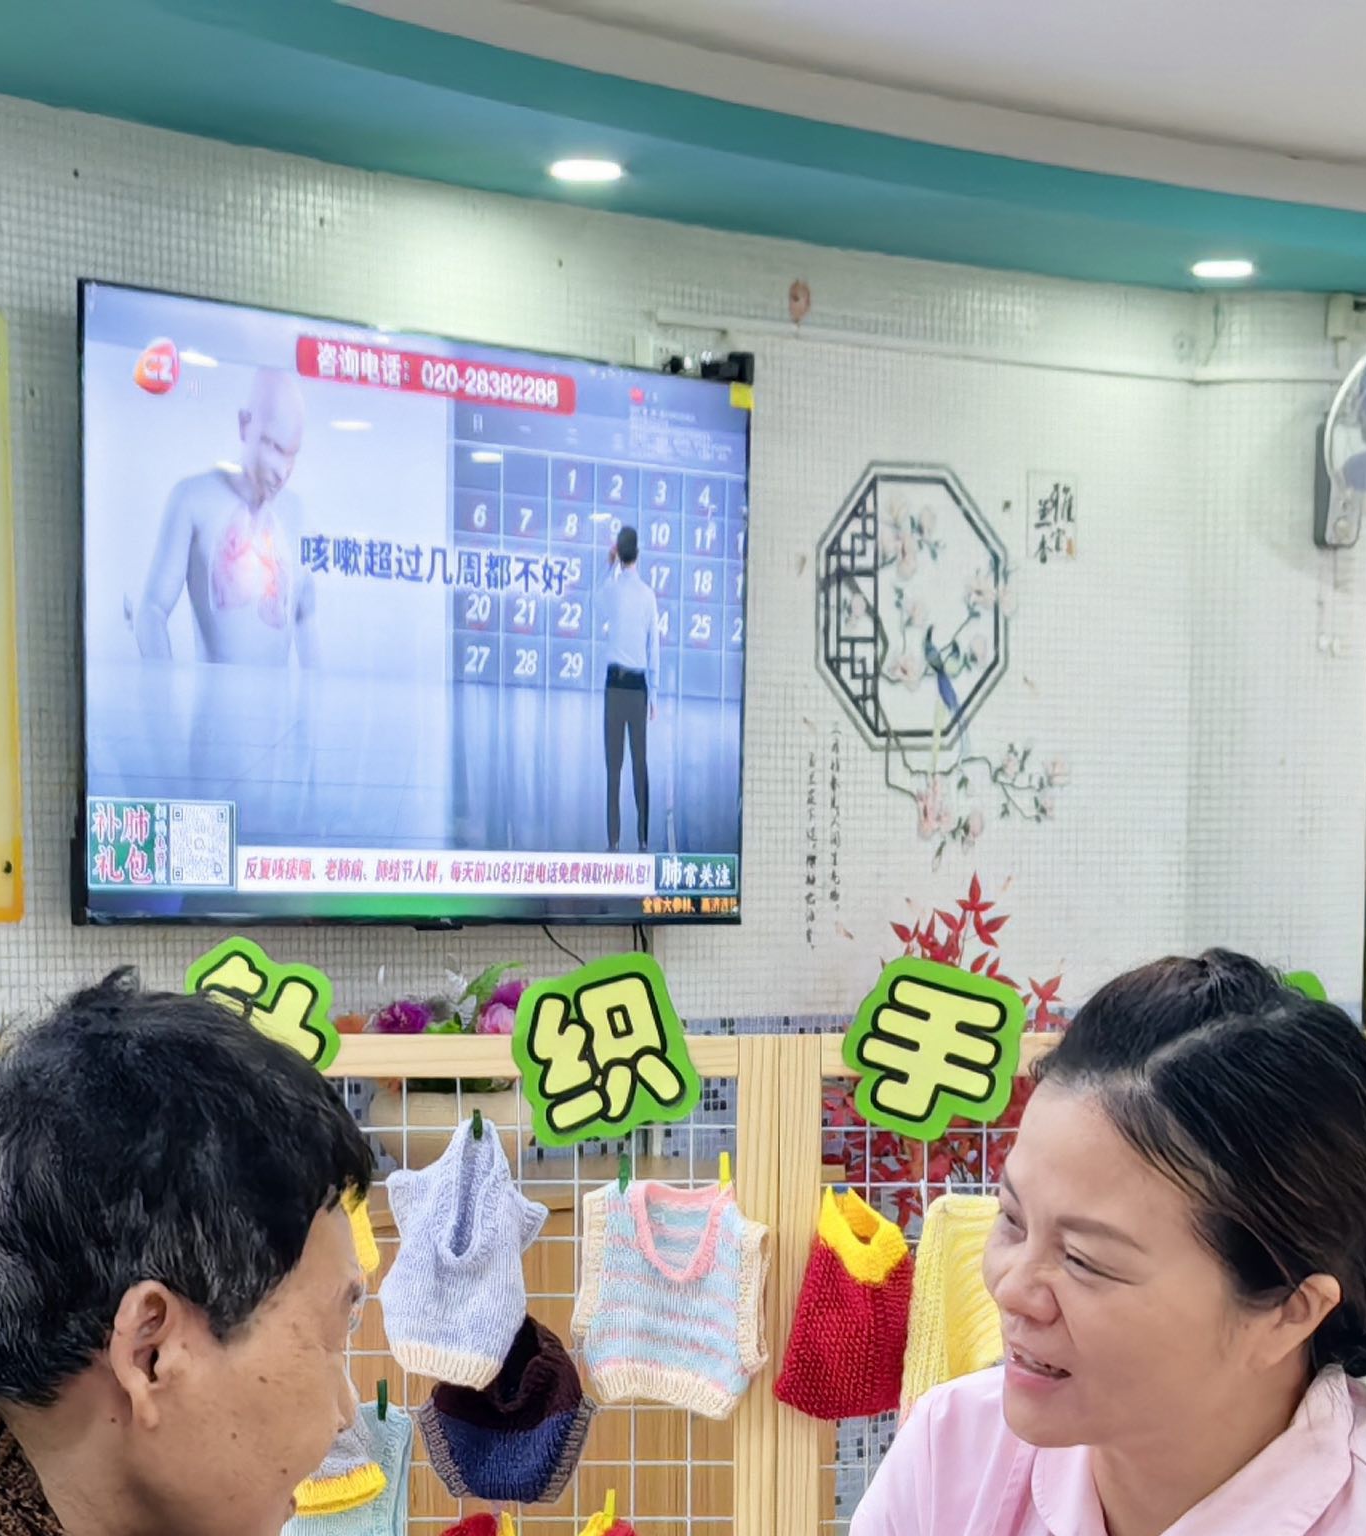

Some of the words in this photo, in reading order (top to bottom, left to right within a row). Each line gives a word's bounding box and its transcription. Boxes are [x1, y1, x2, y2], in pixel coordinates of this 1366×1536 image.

[420, 360, 559, 409] 020-28382288
[567, 469, 577, 493] 1
[611, 474, 623, 499] 2
[654, 480, 667, 505] 3
[698, 485, 711, 509] 4
[473, 504, 487, 528] 6
[519, 508, 533, 532] 7
[565, 513, 579, 537] 8
[650, 522, 671, 545] 10
[299, 534, 569, 597] 咳嗽超过几周都不好
[650, 564, 670, 590] 17
[693, 569, 713, 594] 18
[465, 595, 492, 621] 20
[513, 598, 536, 625] 21
[558, 602, 582, 629] 22
[689, 613, 712, 640] 25
[464, 646, 491, 673] 27
[513, 649, 538, 676] 28
[559, 652, 584, 679] 29
[91, 802, 152, 846] 补肺
[92, 845, 154, 885] 礼包
[657, 855, 733, 890] 肺常关注
[529, 969, 688, 1135] 织
[854, 973, 1010, 1123] 手
